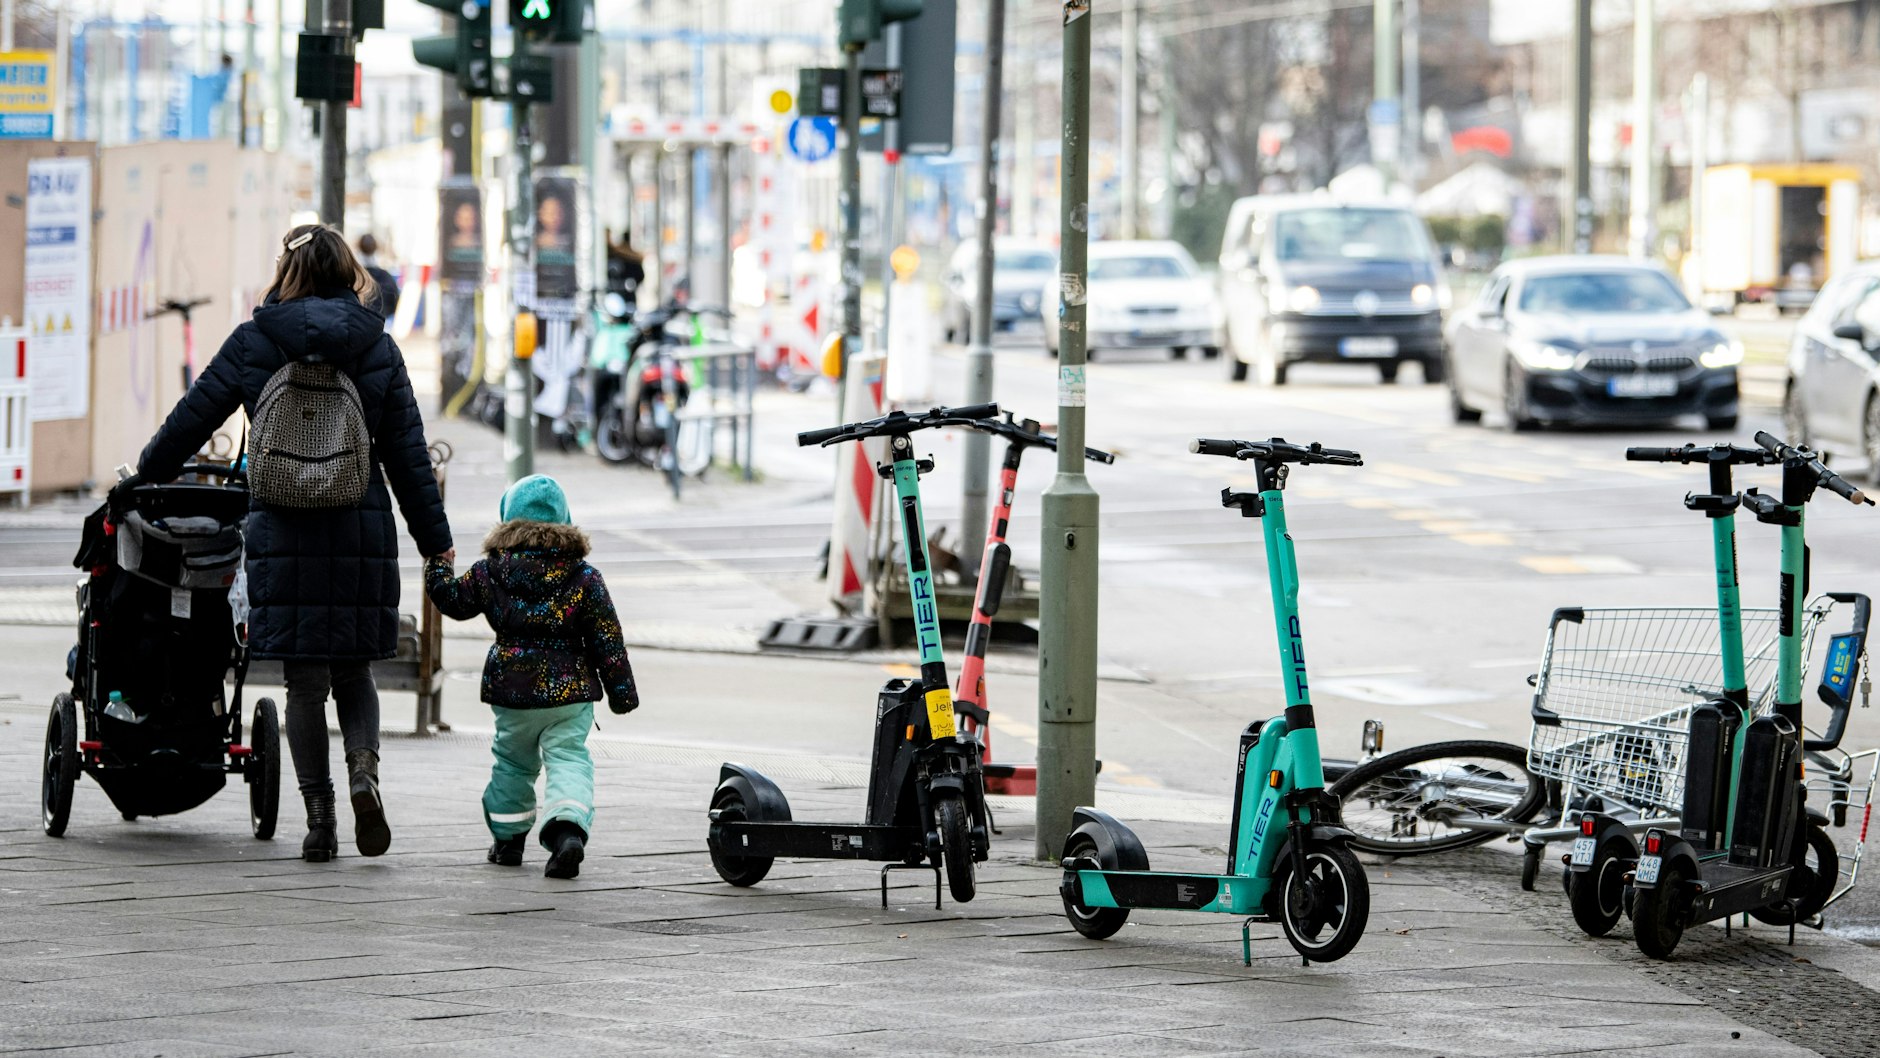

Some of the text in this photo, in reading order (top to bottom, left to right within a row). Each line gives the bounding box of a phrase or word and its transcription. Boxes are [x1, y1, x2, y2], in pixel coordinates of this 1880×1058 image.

[914, 576, 937, 659] TIER
[1288, 615, 1309, 700] TIER
[1238, 744, 1247, 774] TIER
[1247, 797, 1274, 861] TIER
[1576, 840, 1594, 851] 457
[1574, 852, 1592, 863] YTJ
[1640, 857, 1658, 868] 448
[1637, 869, 1656, 881] WMG
